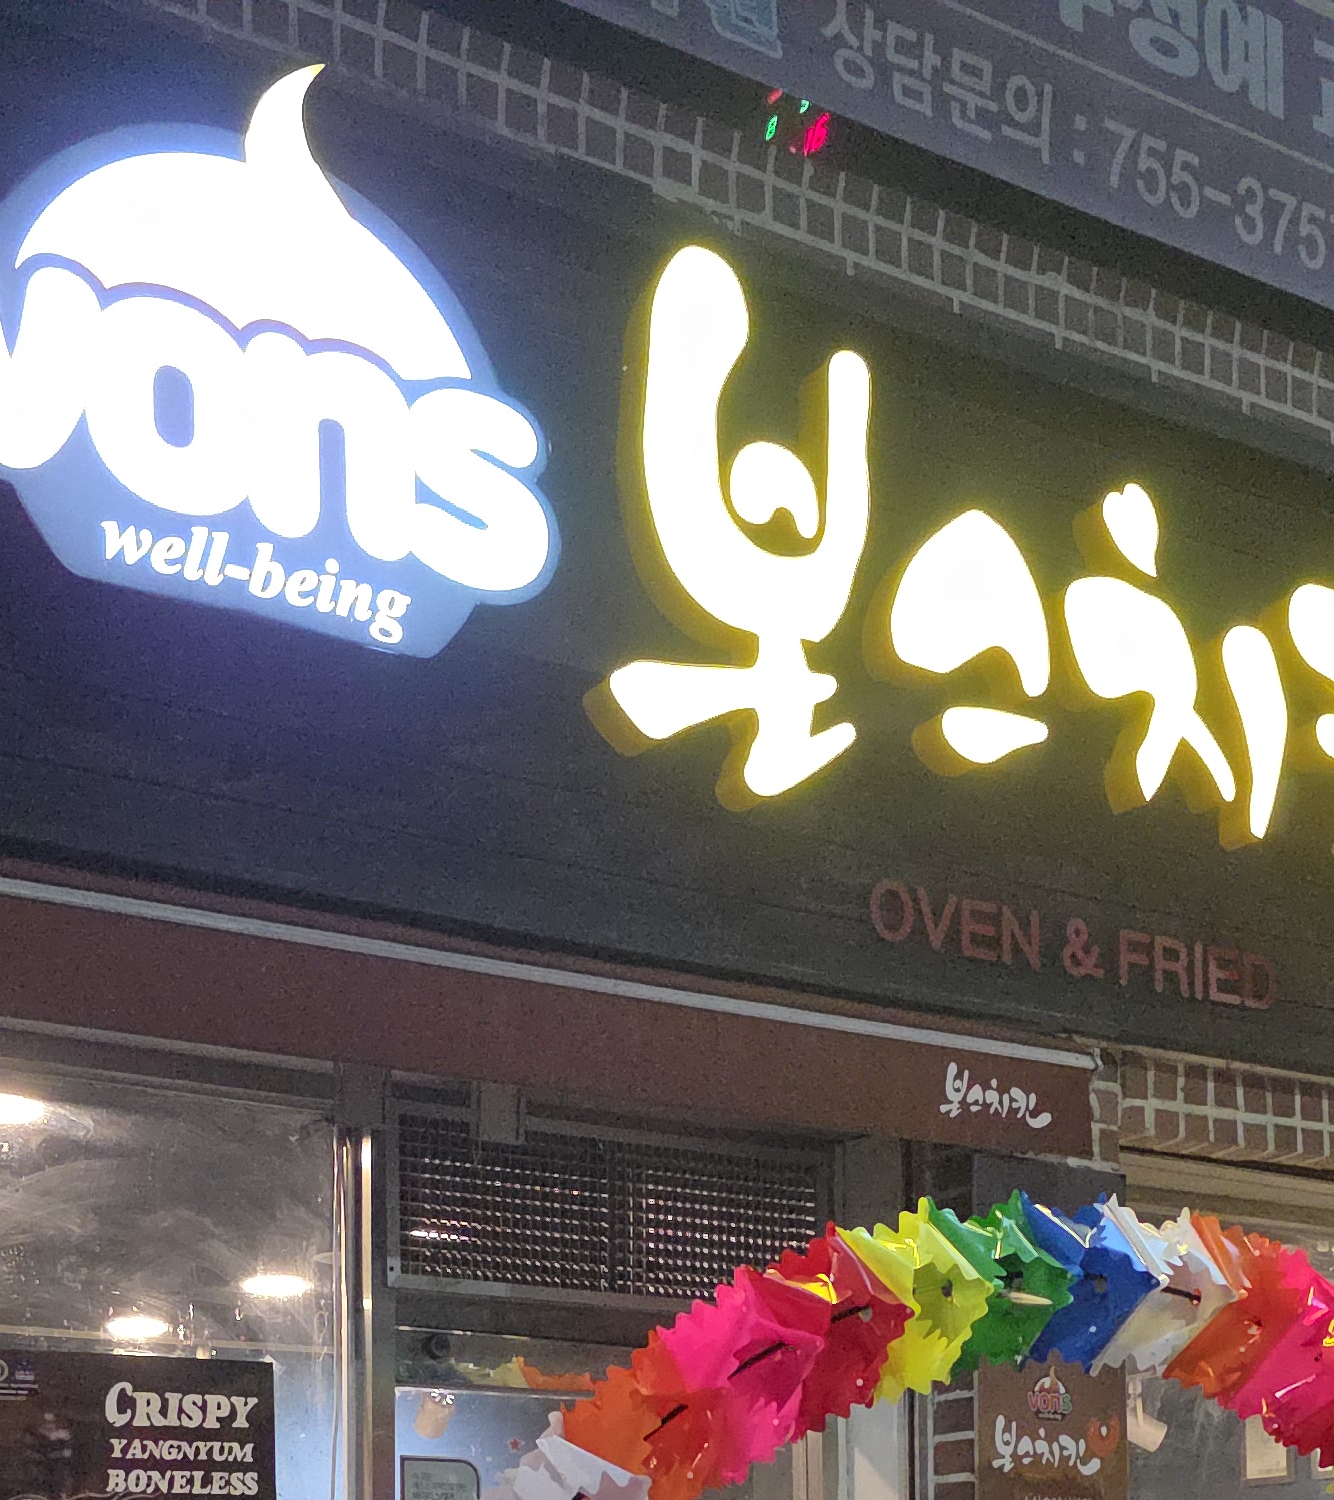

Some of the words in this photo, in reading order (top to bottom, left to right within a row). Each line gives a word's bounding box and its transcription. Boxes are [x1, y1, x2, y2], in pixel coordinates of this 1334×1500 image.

[819, 0, 1057, 165] 상담문의
[99, 519, 413, 645] well-being
[869, 878, 1041, 971] OVEN
[1062, 917, 1105, 979] &
[1118, 929, 1280, 1010] FRIED
[938, 1061, 1053, 1129] 본스치킨
[104, 1381, 259, 1429] CRISPY
[1027, 1391, 1073, 1414] vons
[110, 1438, 255, 1463] YANGNYUM
[991, 1414, 1101, 1476] 본스치킨
[105, 1469, 259, 1496] BONELESS
